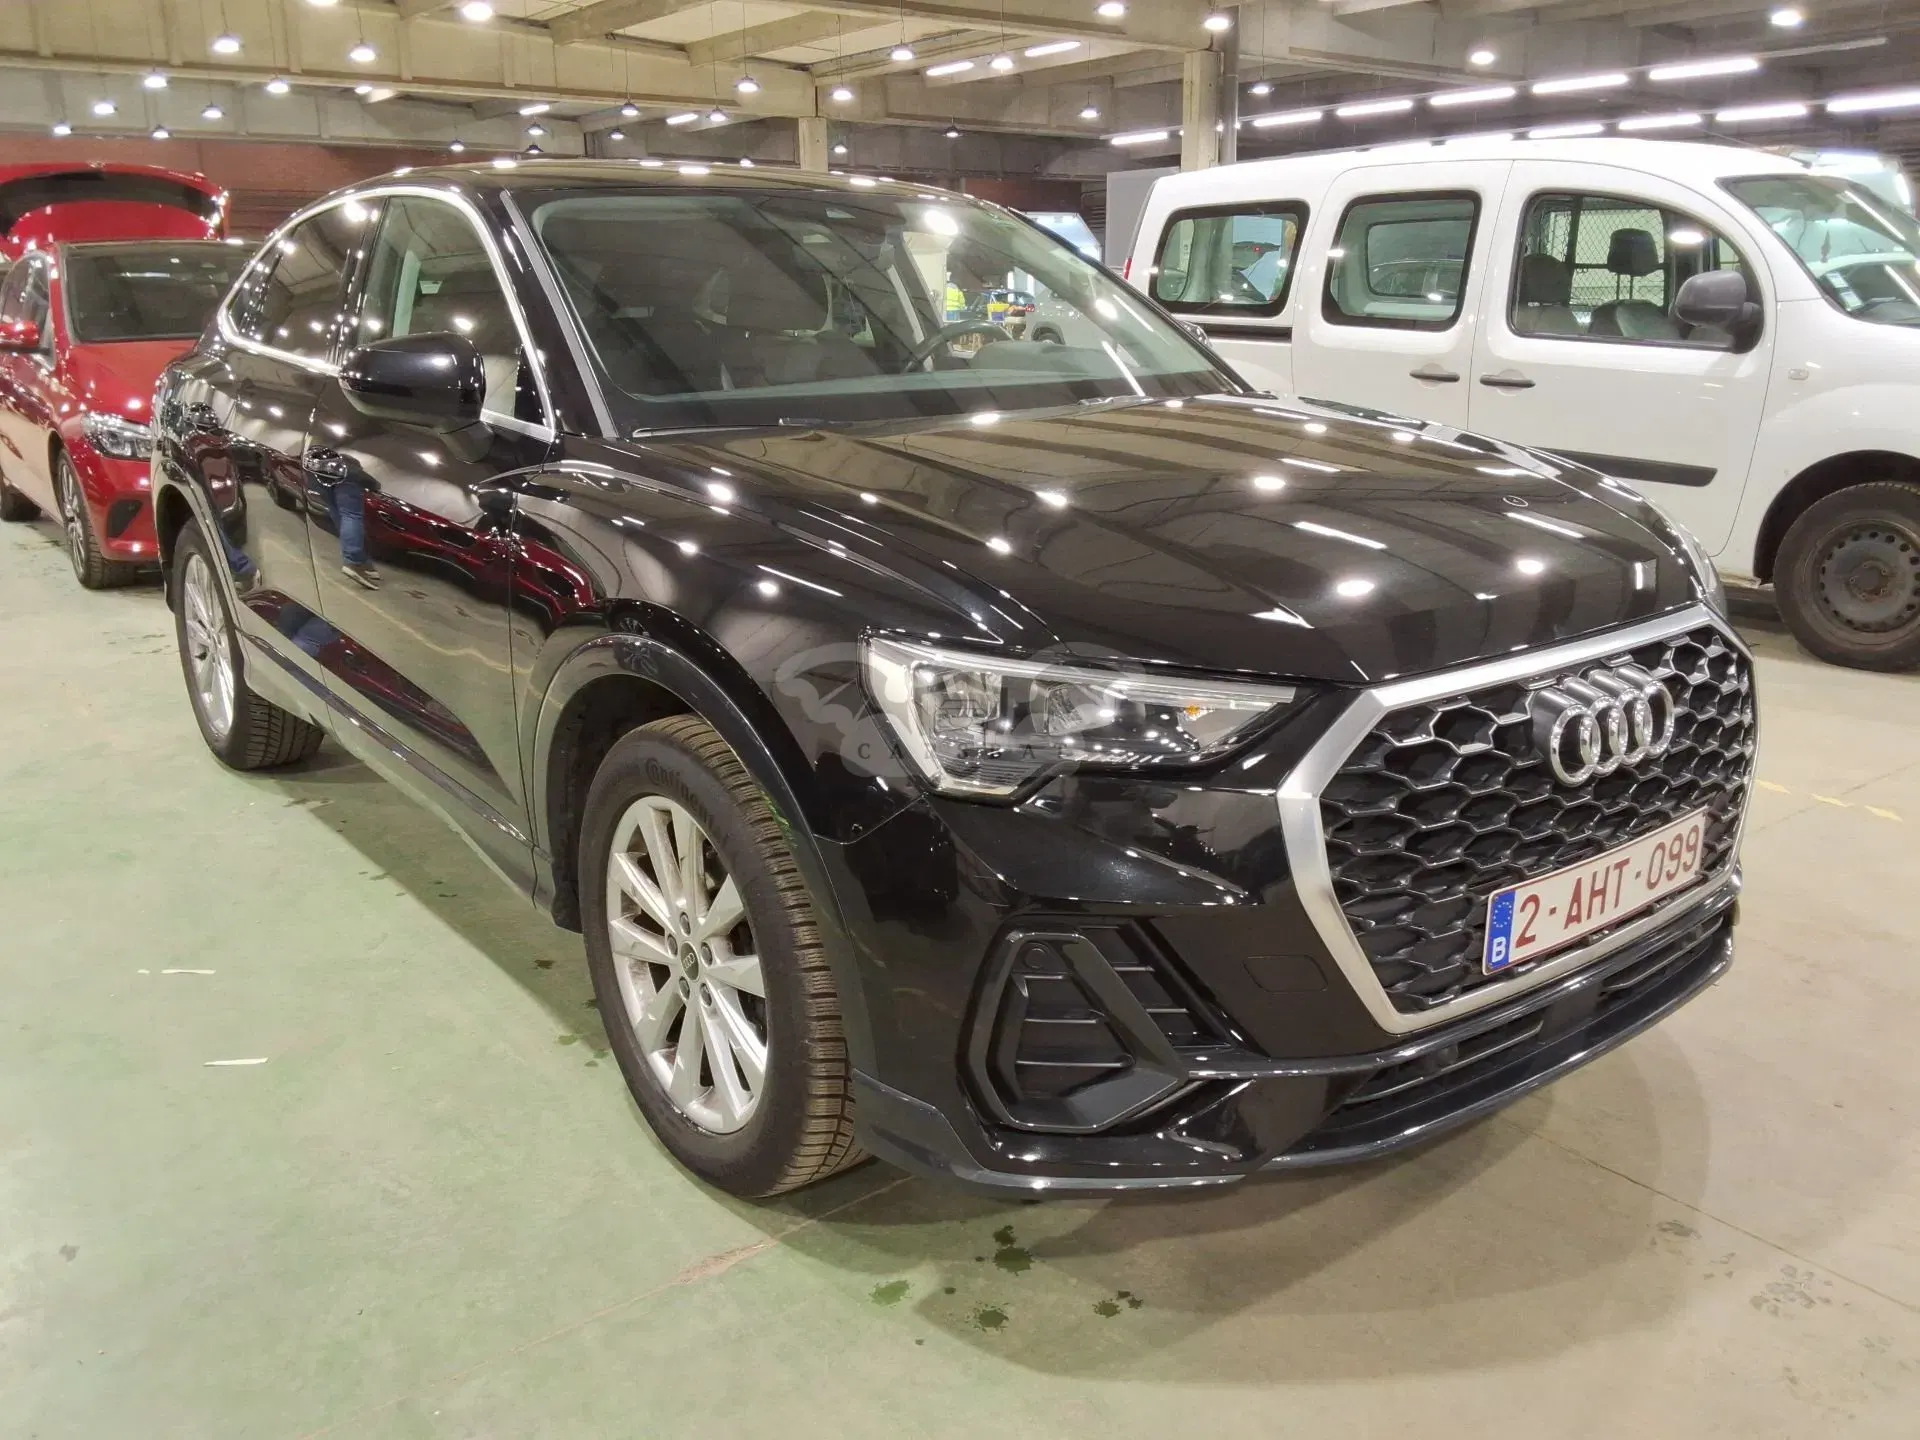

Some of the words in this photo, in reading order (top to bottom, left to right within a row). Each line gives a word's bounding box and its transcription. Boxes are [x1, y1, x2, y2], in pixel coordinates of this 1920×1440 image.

[645, 757, 731, 848] Continentl
[1515, 824, 1700, 949] 2-AHT-099
[1490, 936, 1507, 963] B
